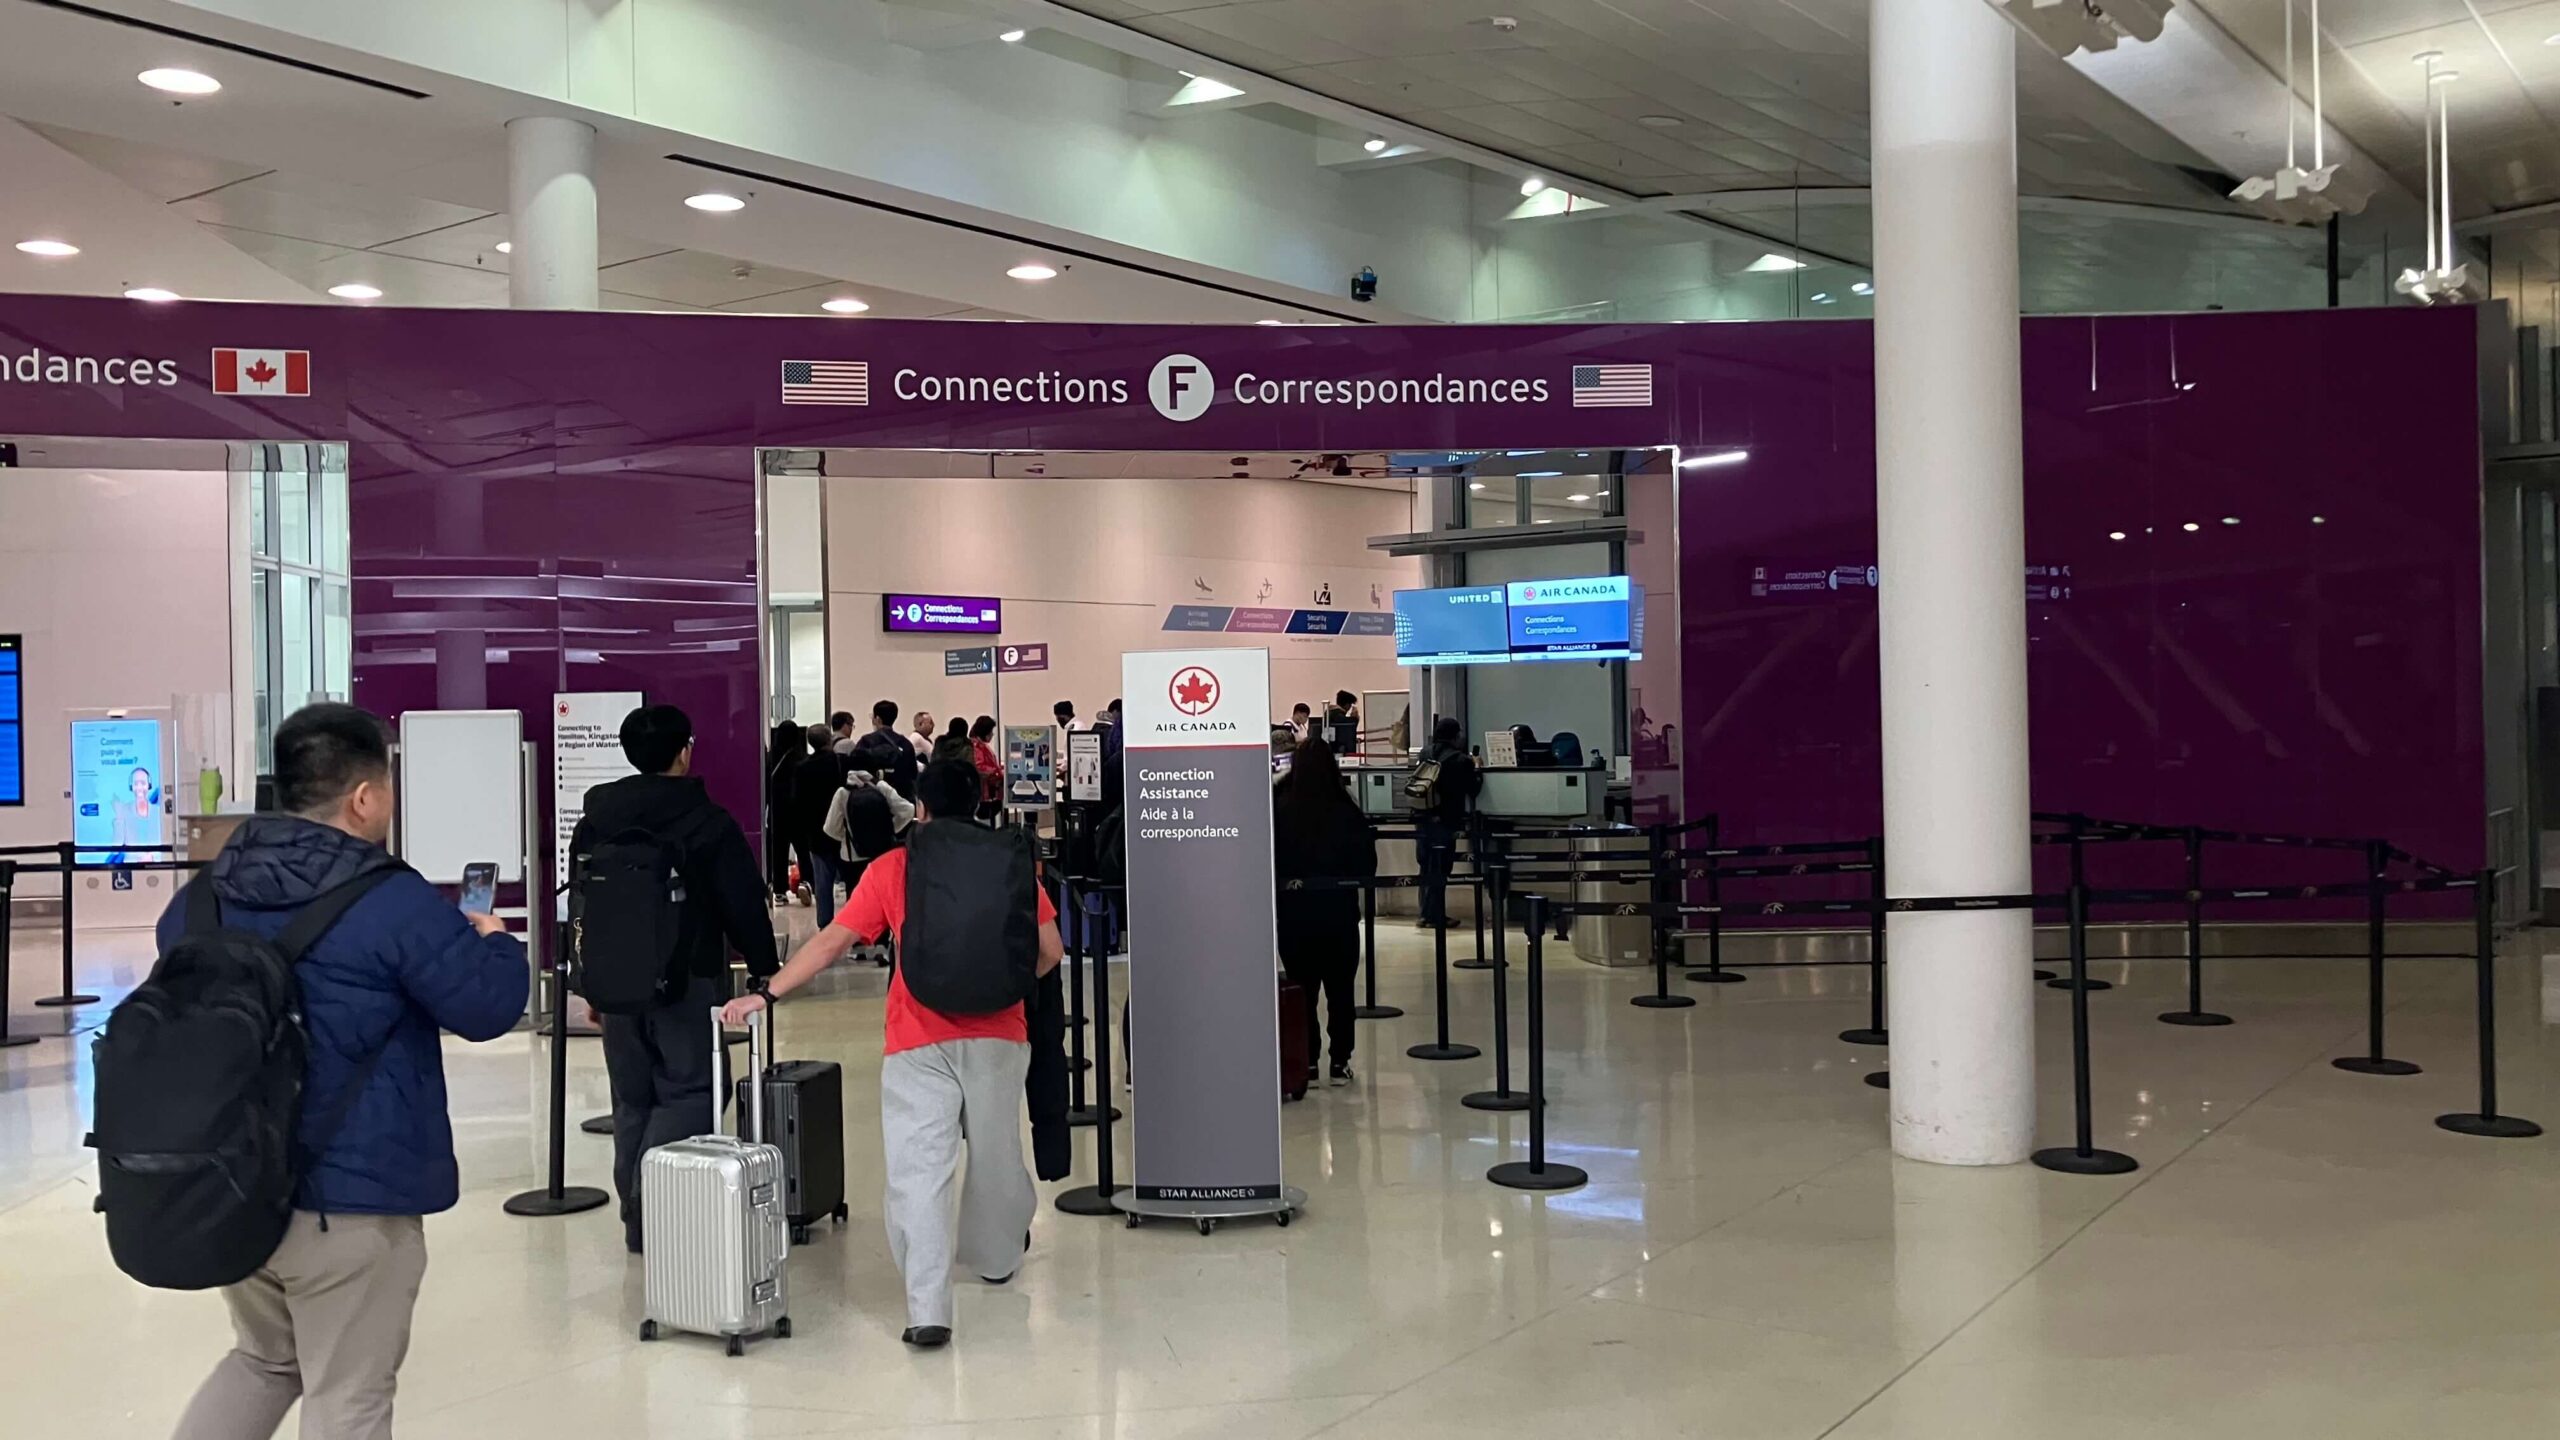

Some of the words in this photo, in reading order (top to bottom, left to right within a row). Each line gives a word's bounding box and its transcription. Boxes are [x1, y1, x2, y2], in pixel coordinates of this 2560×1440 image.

[894, 368, 1129, 403] Connections
[1168, 365, 1197, 410] F
[1234, 373, 1549, 410] Correspondances
[1540, 588, 1561, 597] AIR
[1564, 585, 1616, 596] CANADA
[1449, 594, 1490, 604] UNITED
[924, 604, 964, 614] Connections
[924, 614, 979, 624] Correspondances
[1525, 615, 1564, 624] Connections
[1155, 723, 1177, 732] AIR
[1181, 722, 1237, 731] CANADA
[589, 733, 620, 741] Kingsto
[1139, 768, 1215, 781] Connection
[1139, 787, 1209, 800] Assistance
[1140, 808, 1168, 820] Aide
[1171, 808, 1179, 820] à
[1183, 808, 1194, 819] la
[1140, 825, 1239, 841] correspondance
[1159, 1188, 1187, 1198] STAR
[1190, 1188, 1246, 1199] ALLIANCE
